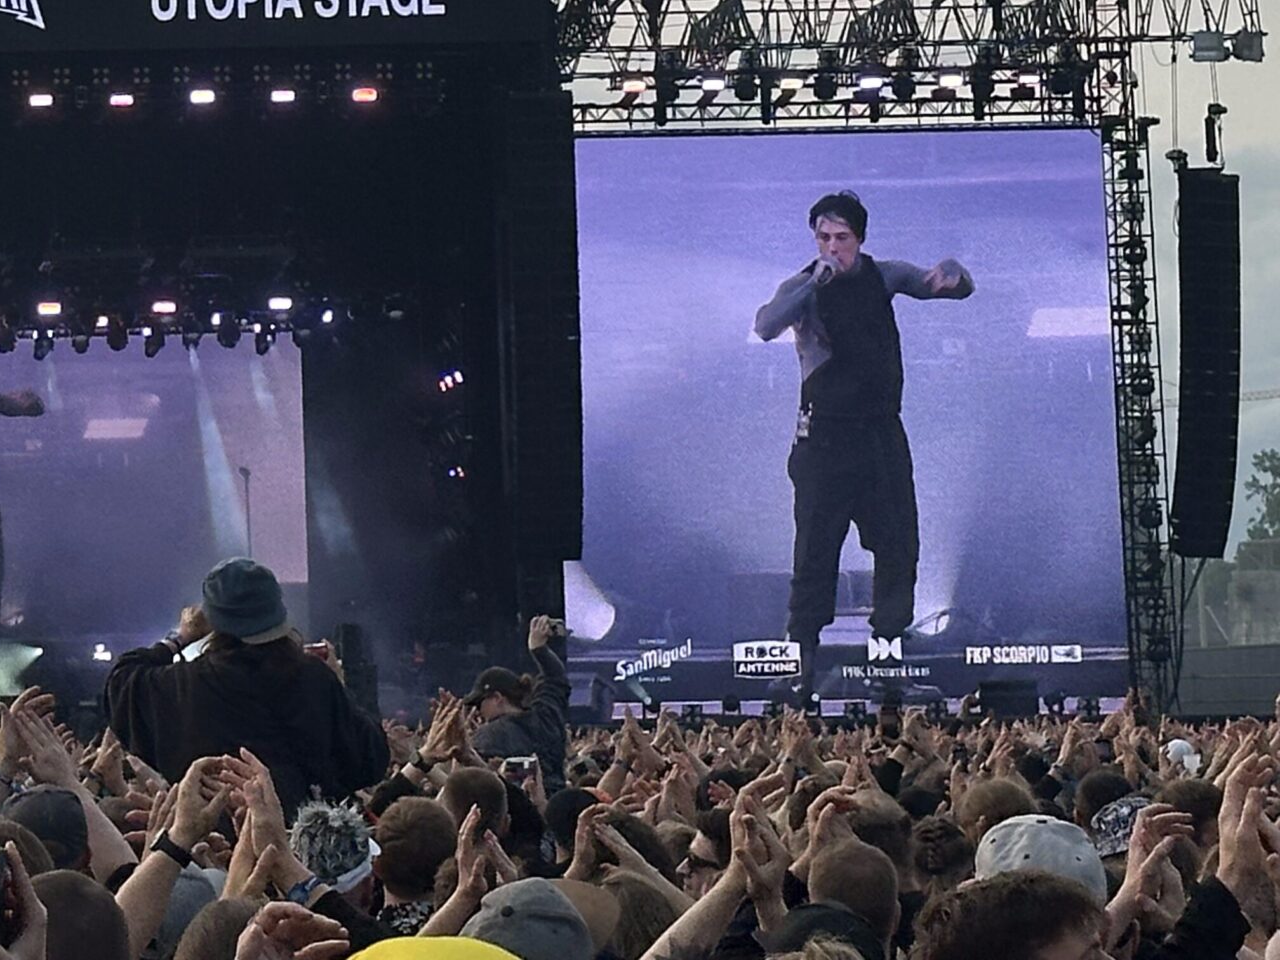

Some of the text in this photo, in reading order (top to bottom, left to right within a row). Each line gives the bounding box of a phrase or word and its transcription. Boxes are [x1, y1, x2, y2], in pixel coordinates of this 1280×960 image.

[744, 645, 790, 659] ROCK
[966, 645, 1049, 664] FKP SCORPIO
[738, 662, 797, 673] ANTENNE
